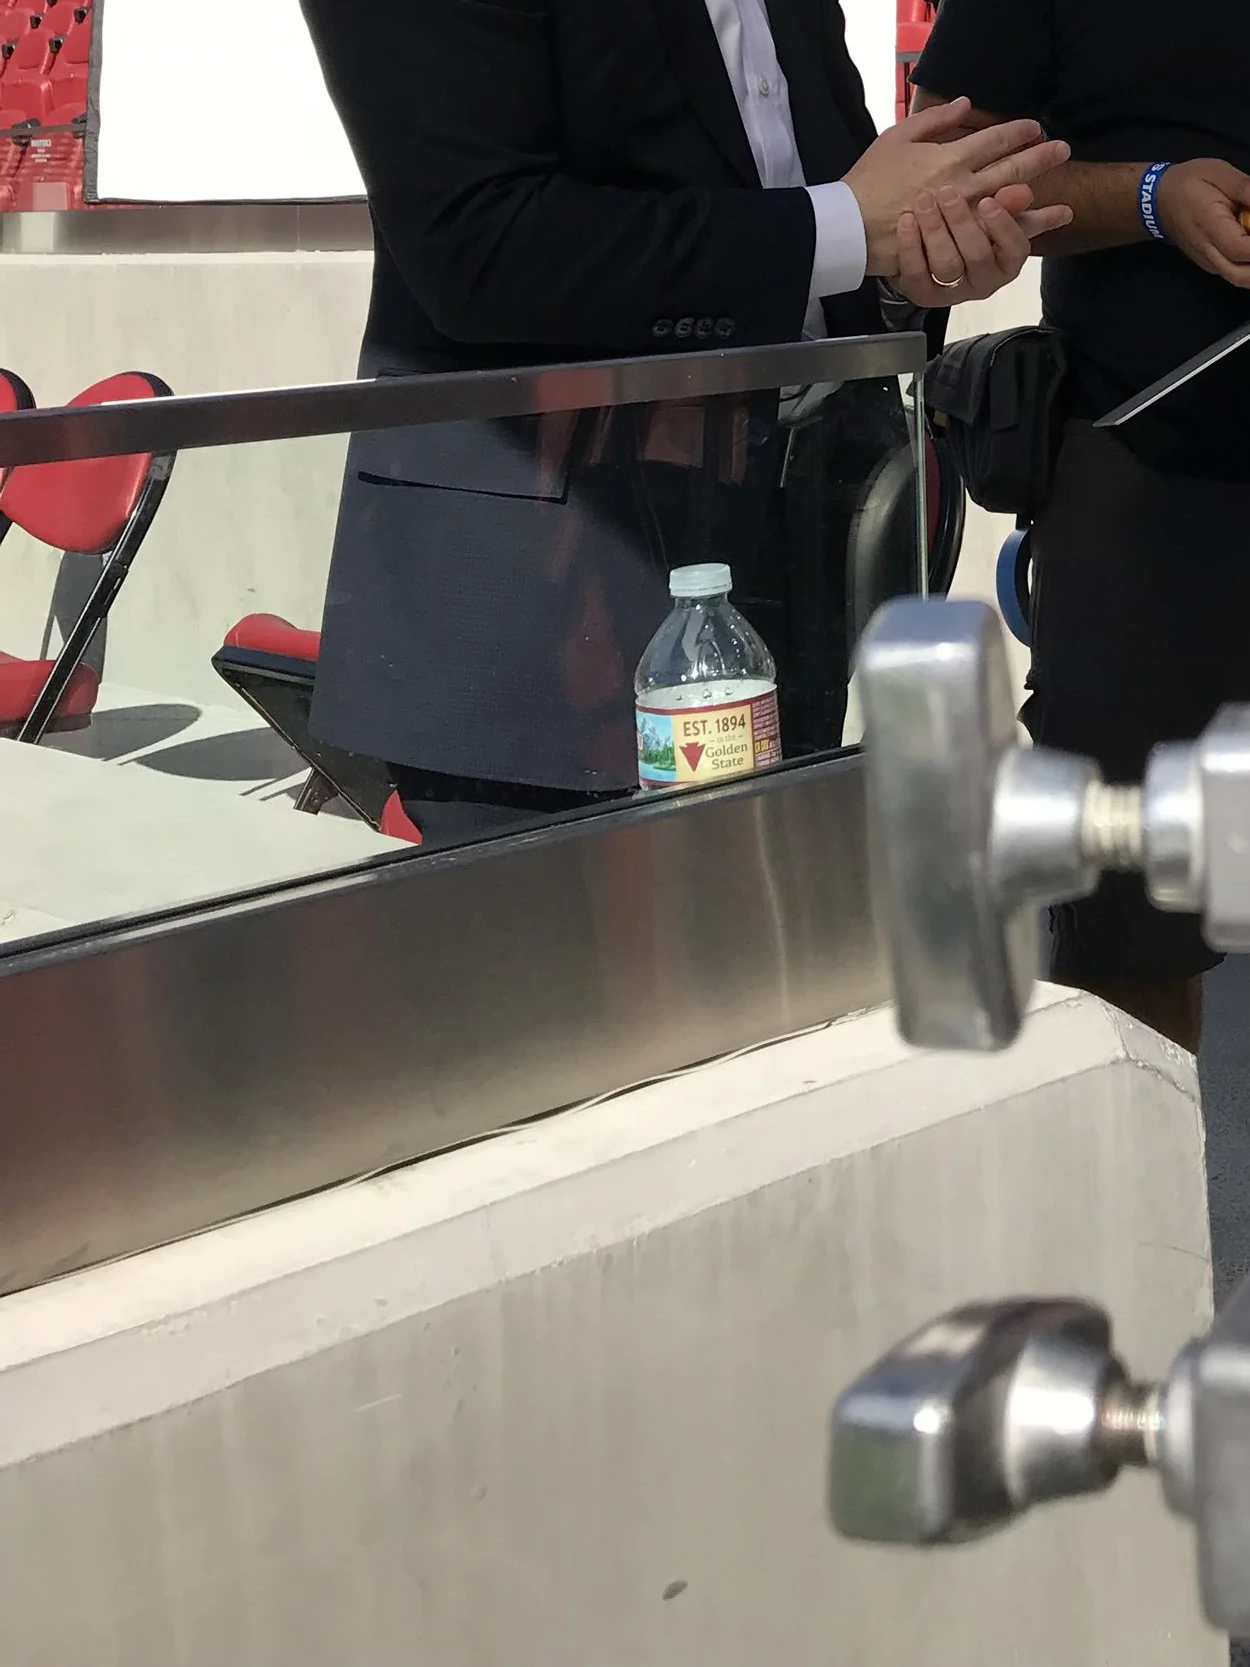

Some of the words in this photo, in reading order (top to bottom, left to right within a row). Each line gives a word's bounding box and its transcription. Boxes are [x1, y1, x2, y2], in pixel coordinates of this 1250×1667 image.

[1141, 173, 1165, 239] STADIUM
[683, 719, 712, 737] EST.
[715, 713, 747, 733] 1894
[705, 742, 748, 758] Golden
[712, 755, 744, 770] State
